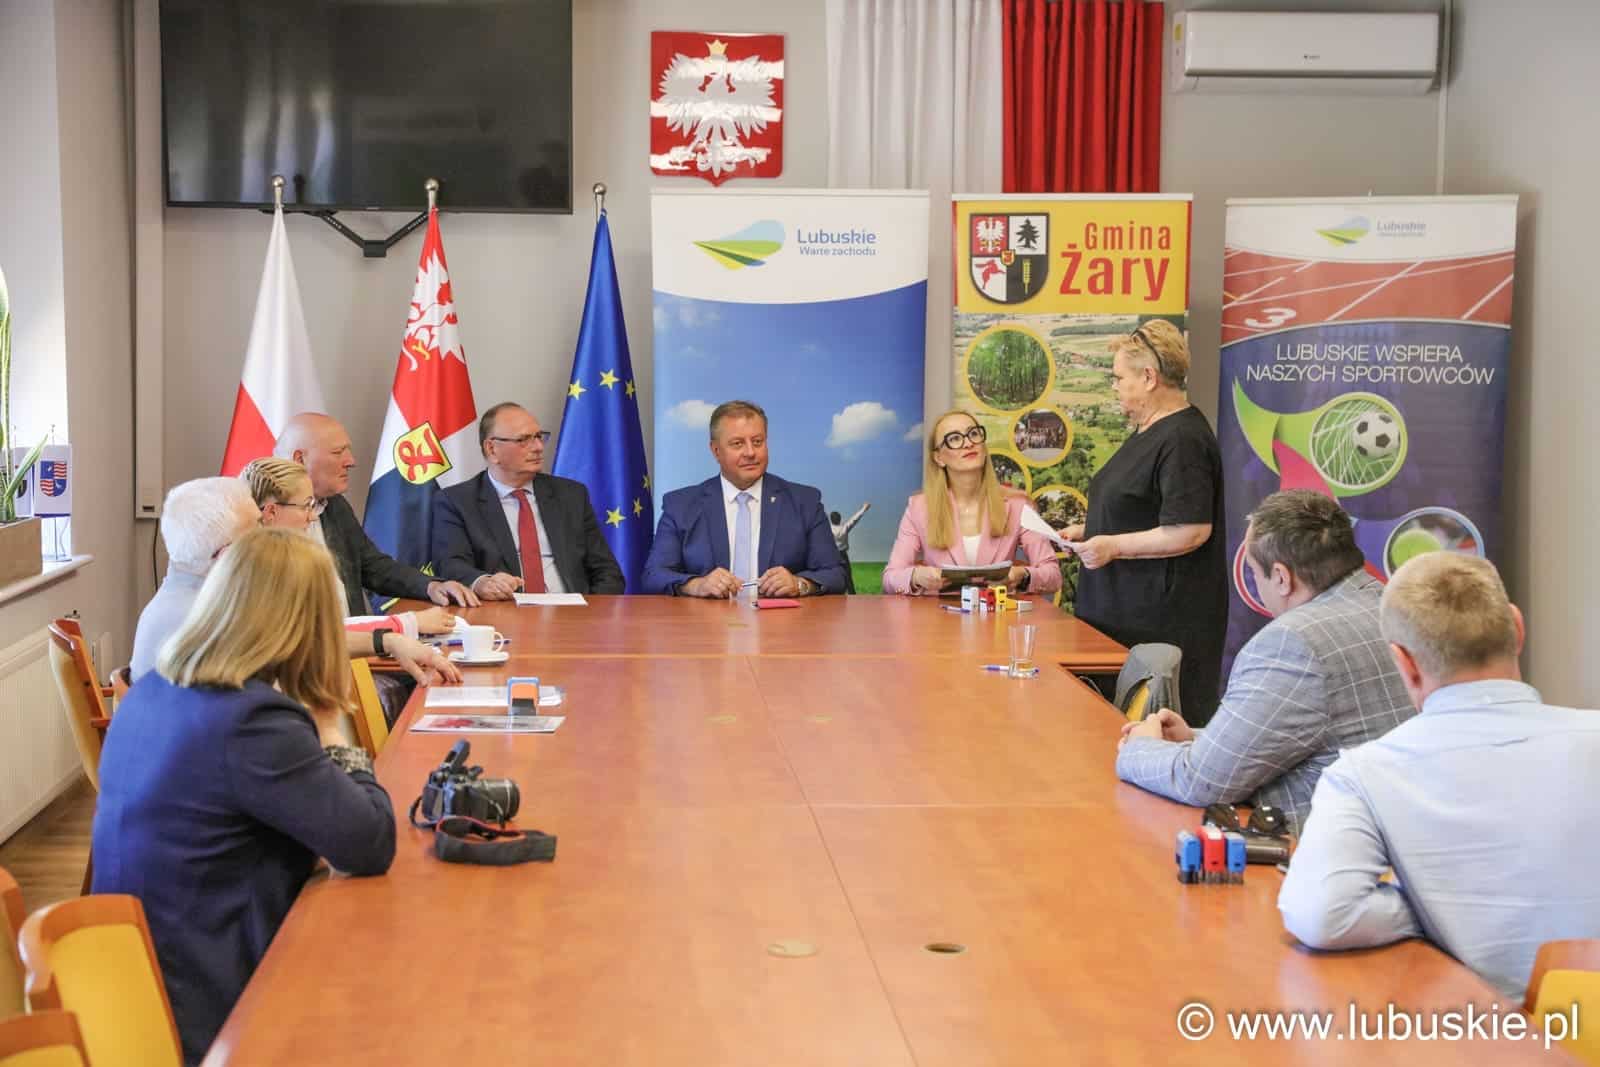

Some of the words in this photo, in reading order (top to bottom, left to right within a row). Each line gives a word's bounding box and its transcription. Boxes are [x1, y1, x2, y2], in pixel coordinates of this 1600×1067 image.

[797, 228, 877, 244] Lubuskie
[1085, 221, 1171, 250] Gmina
[1059, 243, 1170, 301] Żary
[1244, 307, 1297, 328] 3
[1276, 344, 1369, 362] LUBUSKIE
[1375, 345, 1464, 363] WSPIERA
[1246, 364, 1336, 382] NASZYCH
[1342, 361, 1495, 385] SPORTOWCÓW
